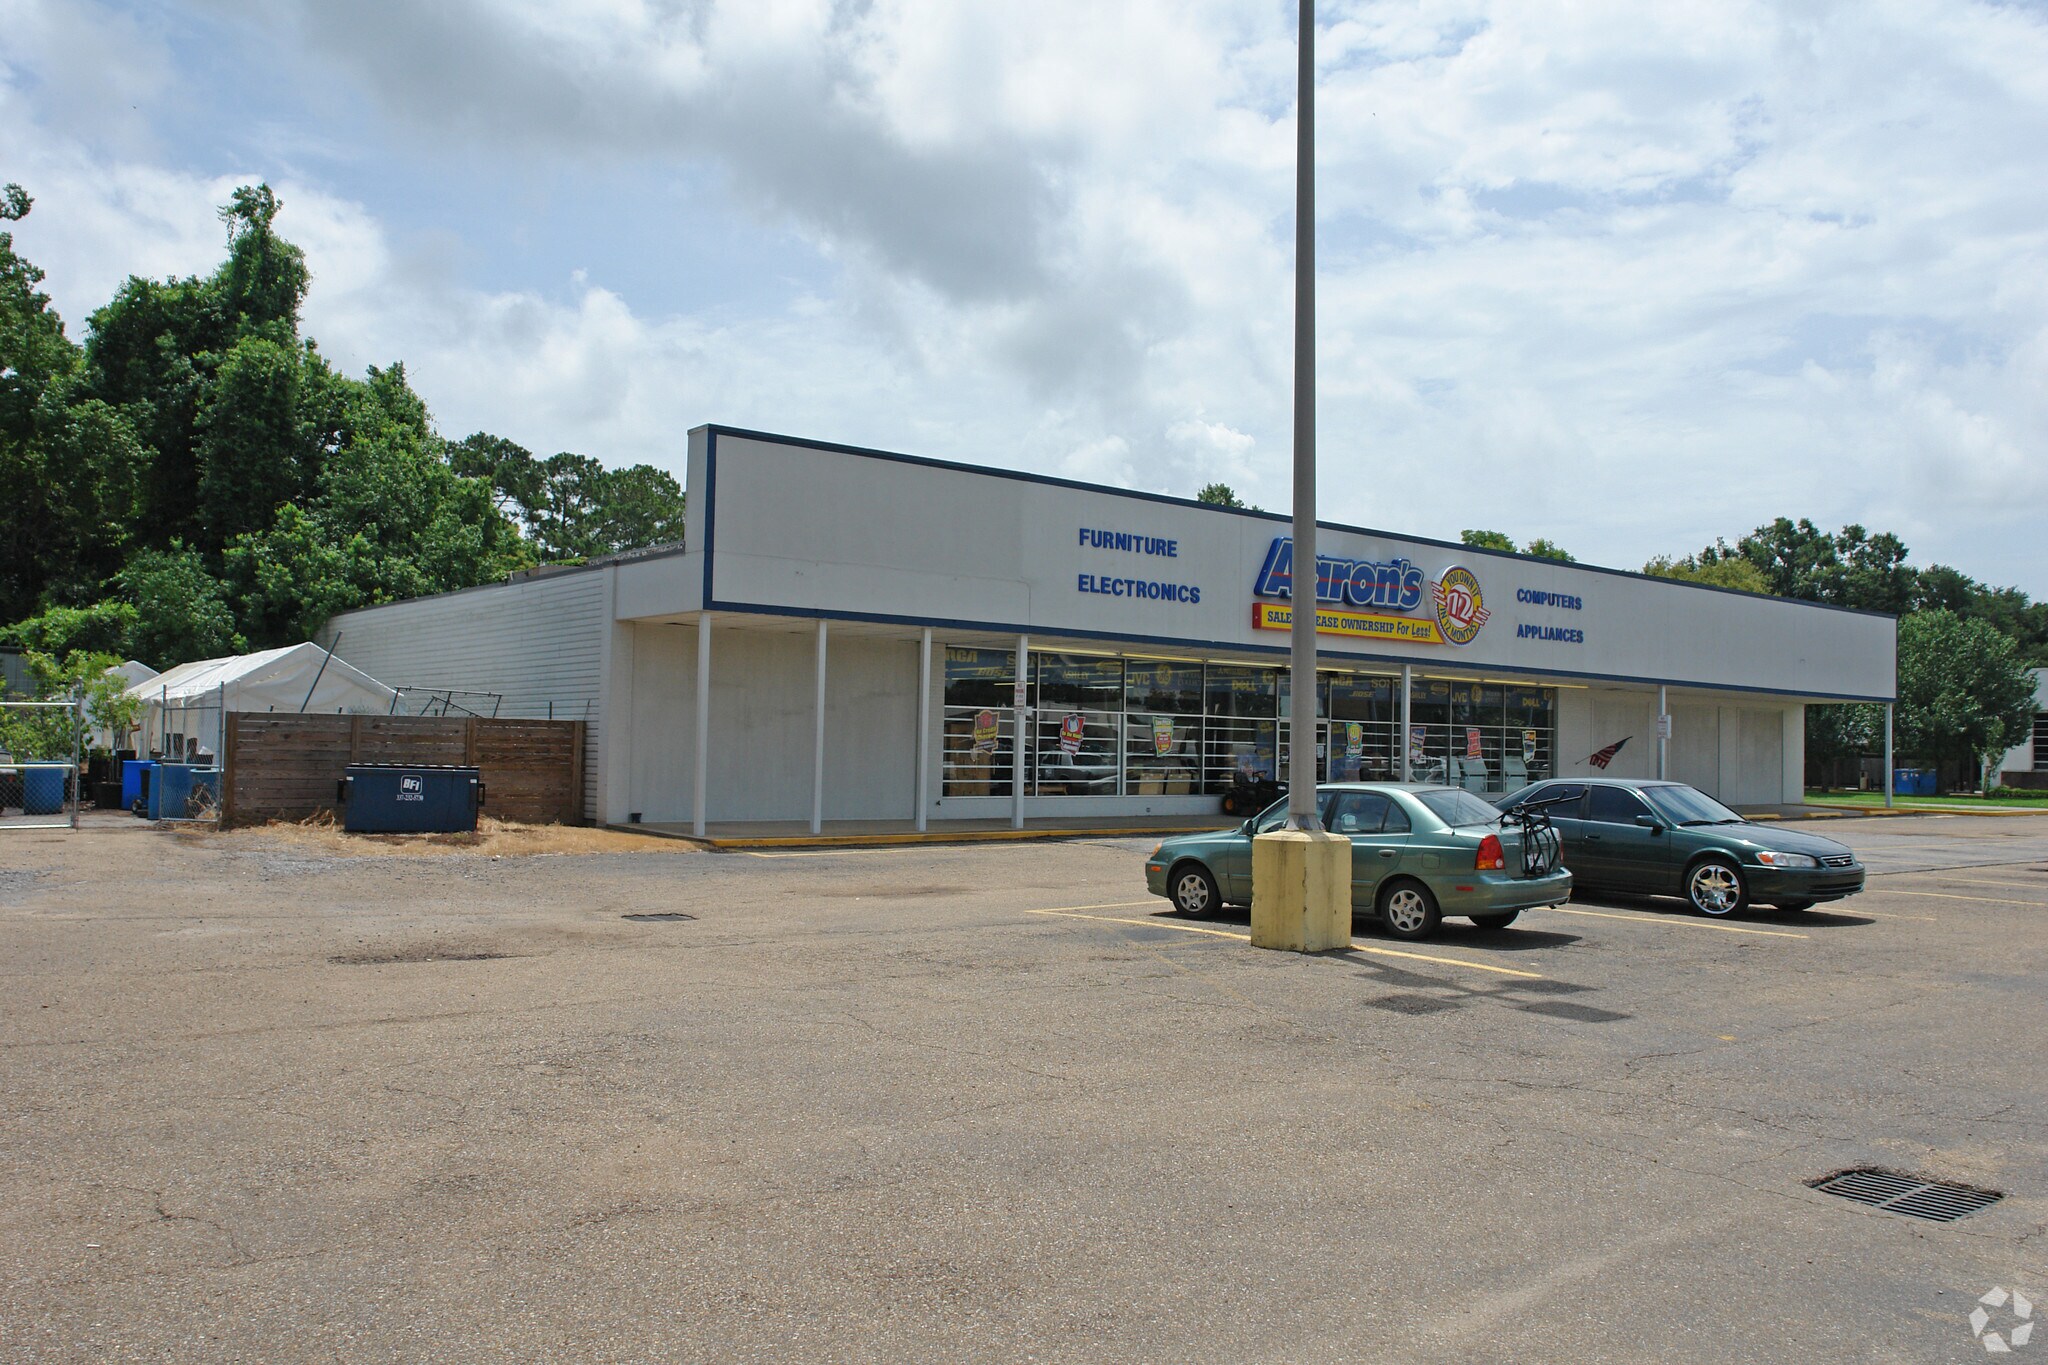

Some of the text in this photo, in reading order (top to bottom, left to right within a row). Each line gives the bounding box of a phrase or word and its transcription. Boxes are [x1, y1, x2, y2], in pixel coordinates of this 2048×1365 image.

[1078, 528, 1178, 558] FURNITURE
[1077, 574, 1201, 604] ELECTRONICS
[1446, 571, 1480, 598] YOU OWN IT
[1516, 588, 1582, 611] COMPUTERS
[1267, 610, 1431, 638] SALE EASE OWNERSHIP For Less!
[1440, 607, 1448, 619] IN
[1450, 622, 1478, 641] MONTHS
[1516, 623, 1584, 644] APPLIANCES
[1006, 653, 1055, 668] SNY
[402, 778, 421, 791] BFI
